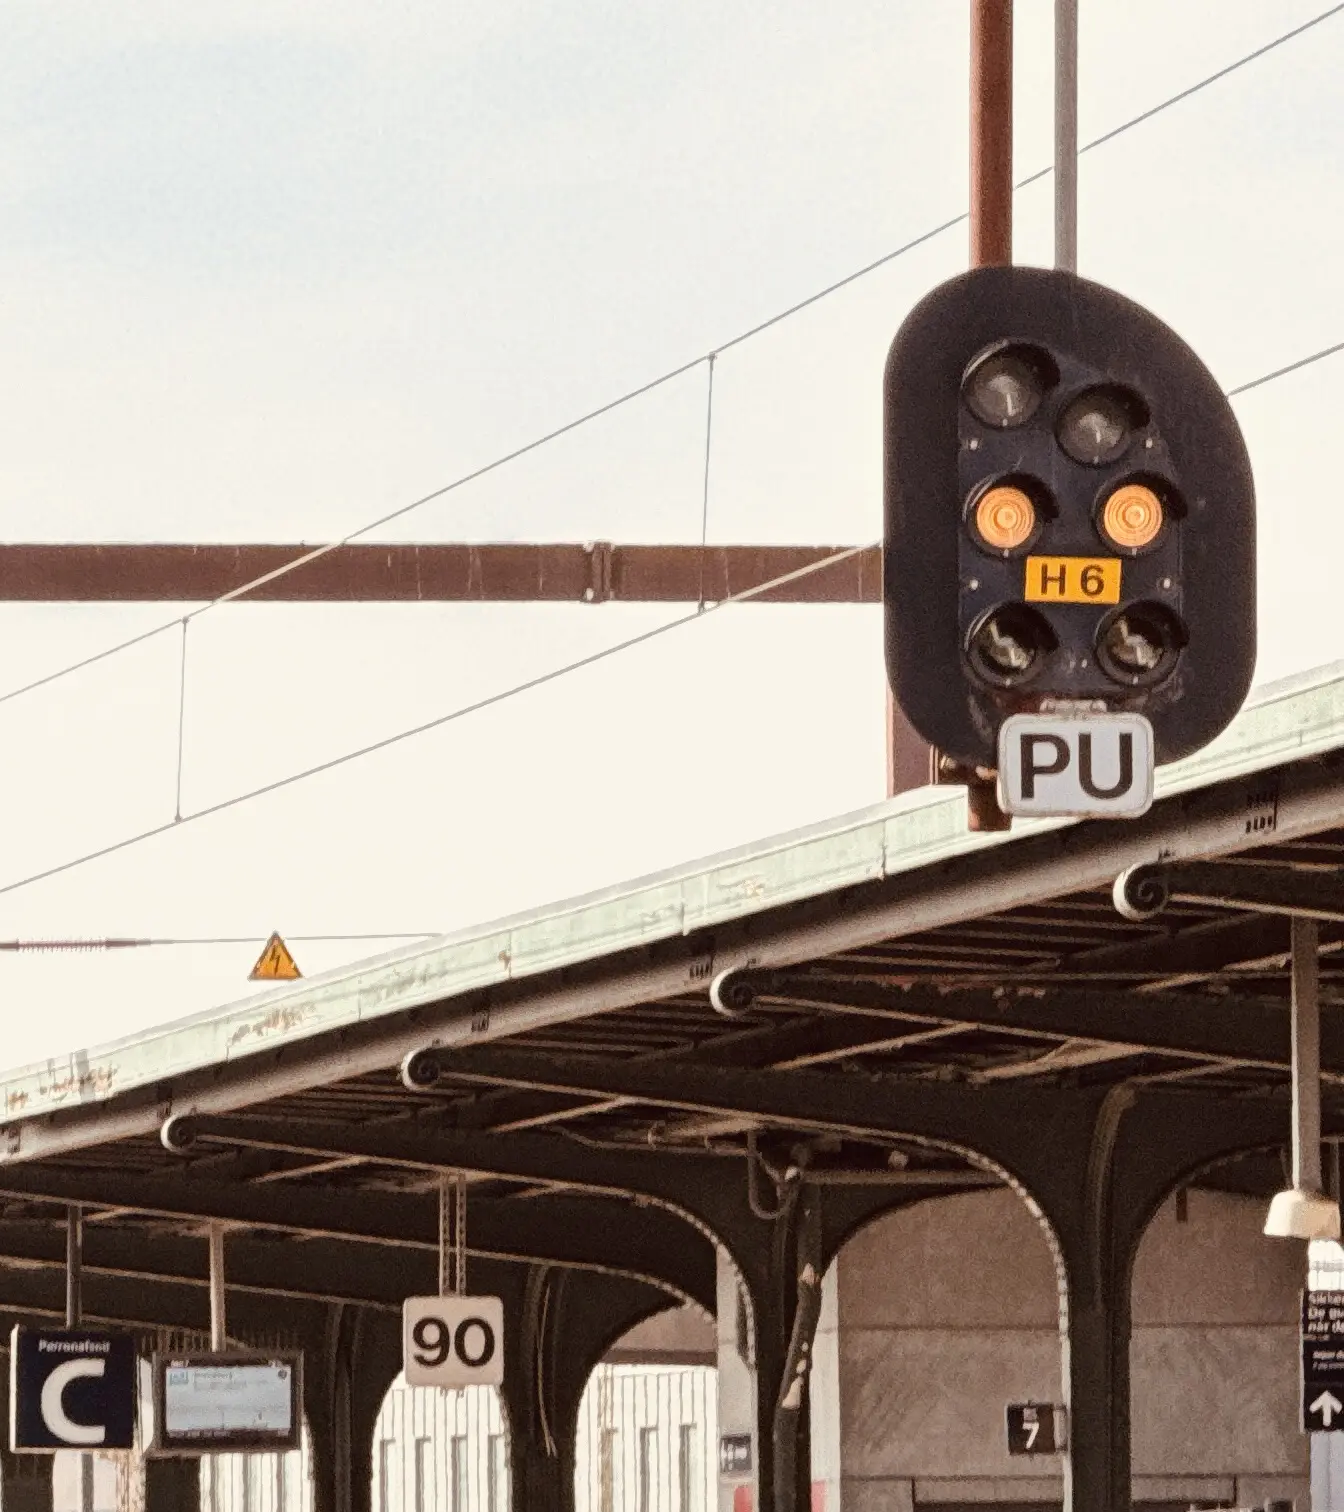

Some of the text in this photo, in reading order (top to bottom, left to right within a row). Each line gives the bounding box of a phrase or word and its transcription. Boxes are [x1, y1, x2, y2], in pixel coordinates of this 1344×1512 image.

[1040, 563, 1105, 598] H 6
[1019, 732, 1133, 800] PU
[412, 1317, 495, 1367] 90
[40, 1357, 106, 1444] C
[1022, 1422, 1040, 1449] 7
